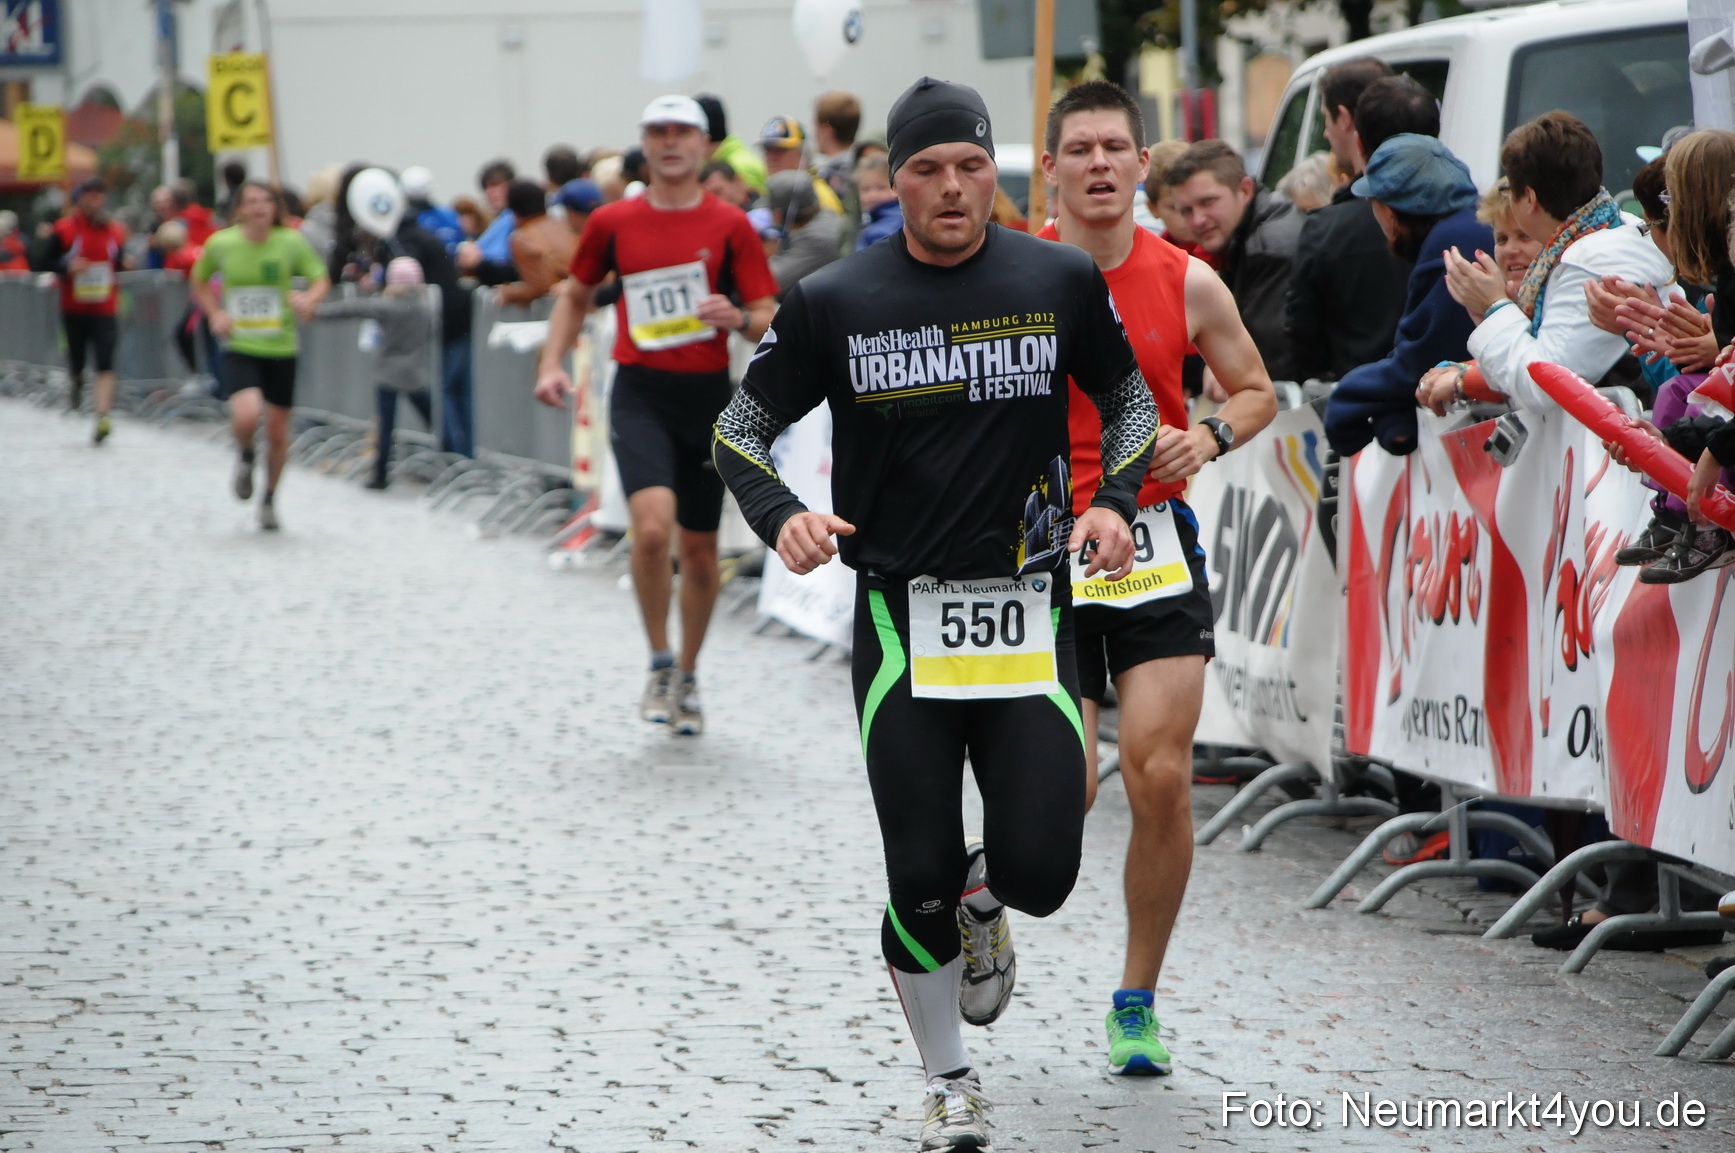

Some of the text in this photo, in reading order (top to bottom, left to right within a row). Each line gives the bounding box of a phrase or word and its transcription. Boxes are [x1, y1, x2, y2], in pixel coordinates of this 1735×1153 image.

[223, 82, 256, 129] C
[29, 124, 56, 162] D
[642, 285, 691, 317] 101
[951, 312, 1055, 333] HAMBURG 2012
[849, 335, 1058, 394] URBANATHLON
[903, 393, 965, 408] mobilcom
[968, 372, 1051, 402] & FESTIVAL
[912, 581, 1027, 595] PARTL Neumarkt
[1083, 572, 1163, 598] Christoph
[941, 599, 1026, 649] 550
